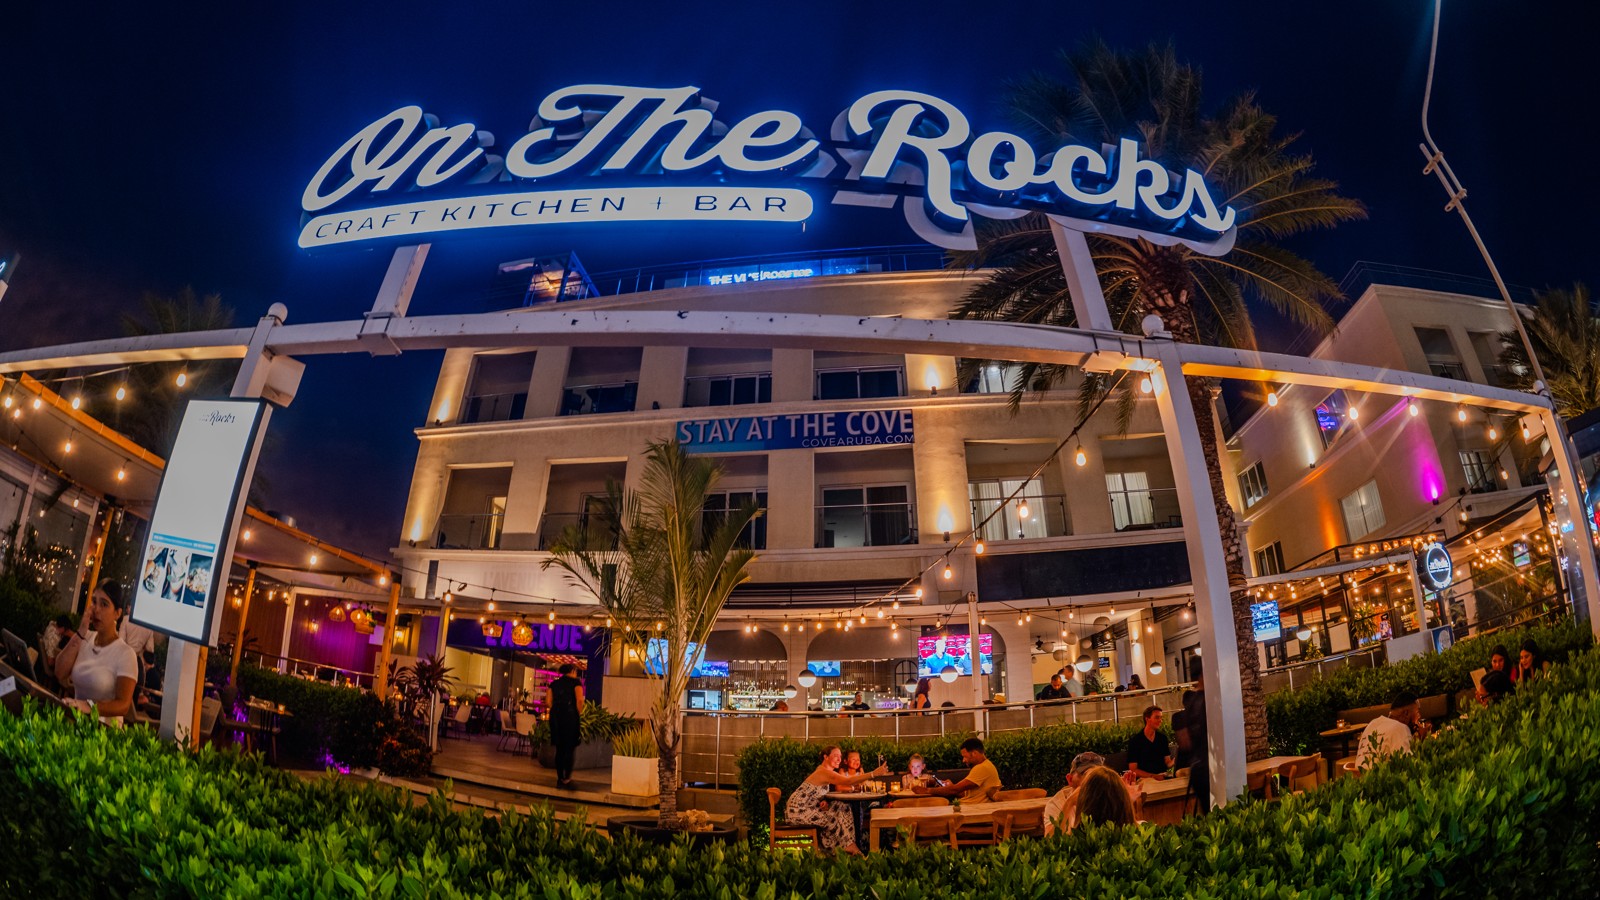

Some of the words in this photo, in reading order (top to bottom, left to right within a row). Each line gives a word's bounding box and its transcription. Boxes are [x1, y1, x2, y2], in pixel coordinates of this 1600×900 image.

[301, 105, 484, 211] On
[505, 84, 820, 178] The
[847, 89, 1236, 232] Rocks
[315, 209, 426, 238] CRAFT
[440, 197, 625, 222] KITCHEN
[694, 195, 788, 212] BAR
[708, 274, 733, 286] THE
[679, 418, 742, 444] STAY
[745, 416, 778, 441] AT
[785, 413, 836, 438] THE
[845, 409, 914, 434] COVE
[801, 433, 915, 448] COVEARUBA.COM
[485, 620, 583, 652] L'AENUE
